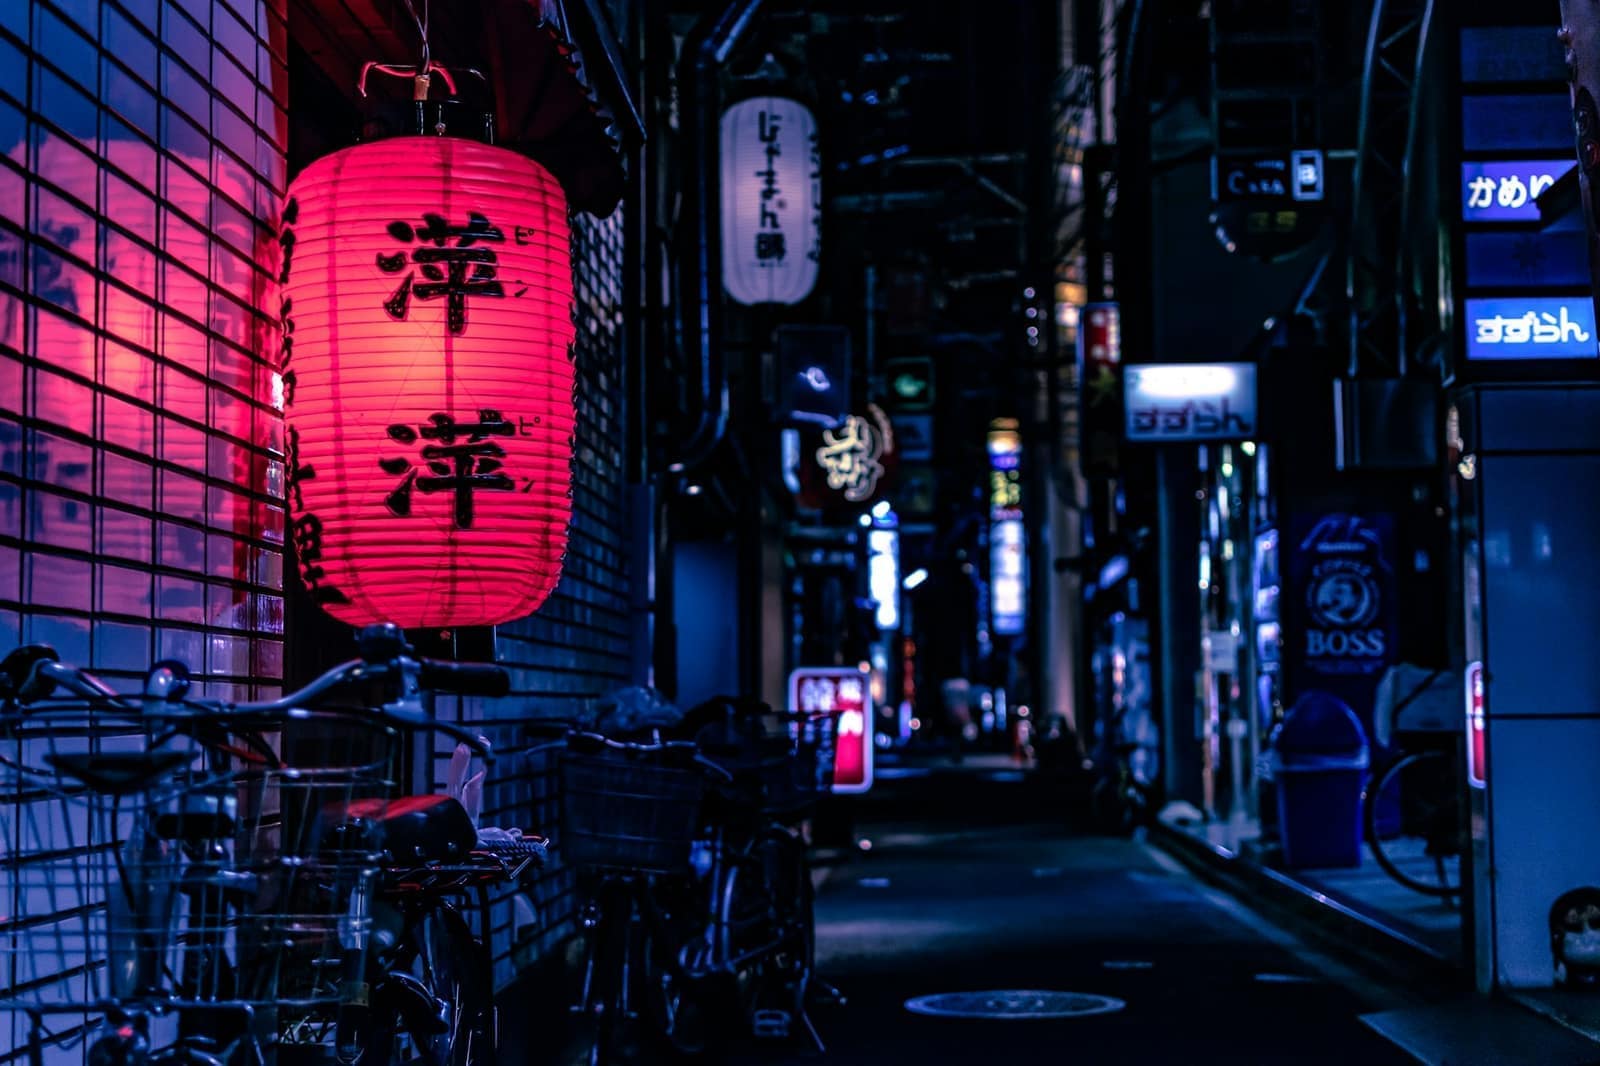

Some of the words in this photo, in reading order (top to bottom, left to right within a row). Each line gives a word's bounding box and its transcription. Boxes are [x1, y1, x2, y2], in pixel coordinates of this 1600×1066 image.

[1475, 306, 1590, 343] すずらん
[1132, 395, 1252, 434] すずらん
[1305, 627, 1386, 658] BOSS
